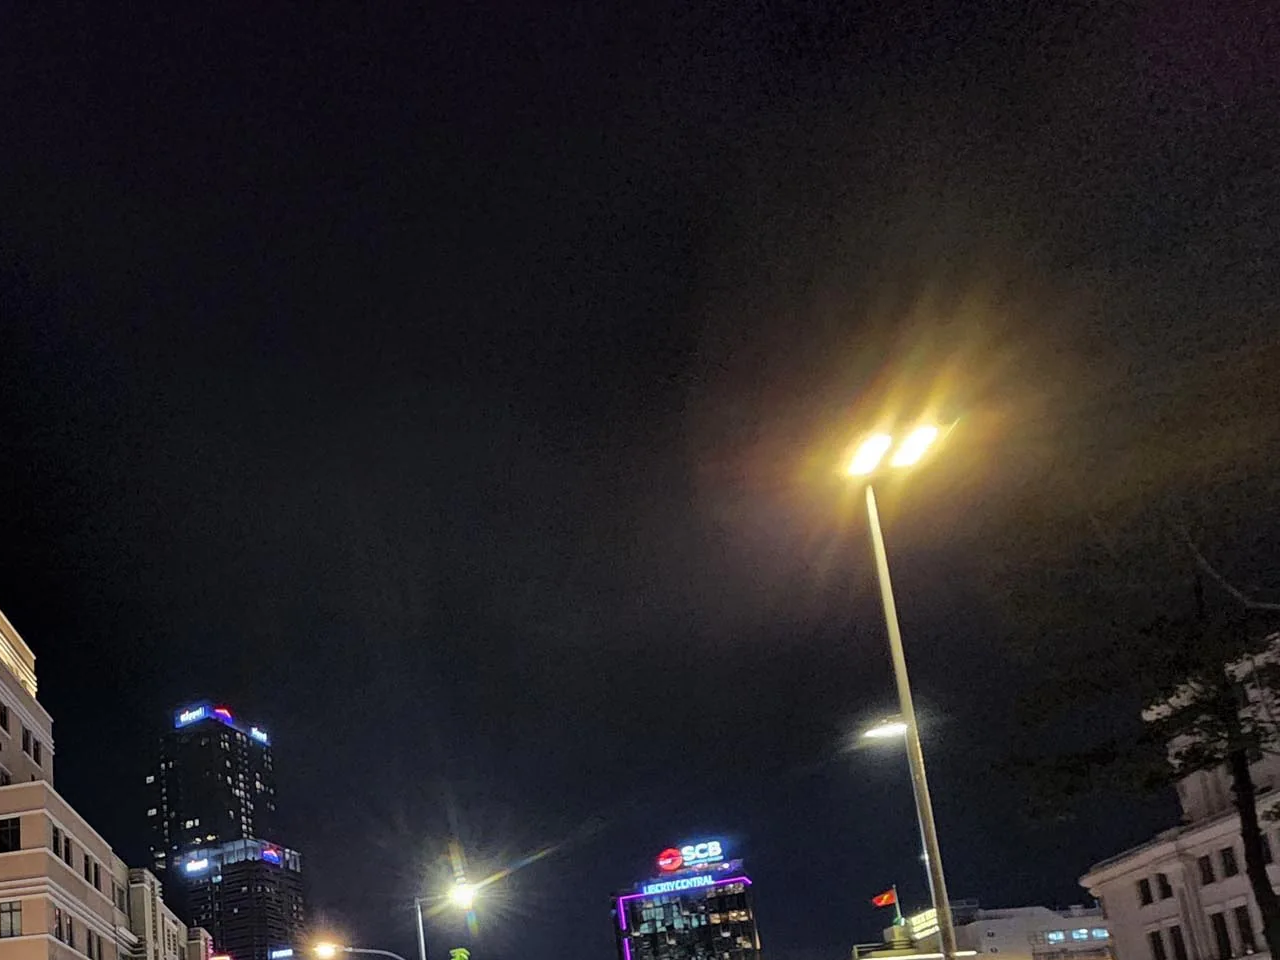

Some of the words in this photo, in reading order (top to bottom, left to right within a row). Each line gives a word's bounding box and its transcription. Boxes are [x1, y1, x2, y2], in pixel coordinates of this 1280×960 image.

[681, 841, 722, 861] SCB
[643, 881, 677, 895] LIBERTY
[675, 875, 715, 892] CENTRAL
